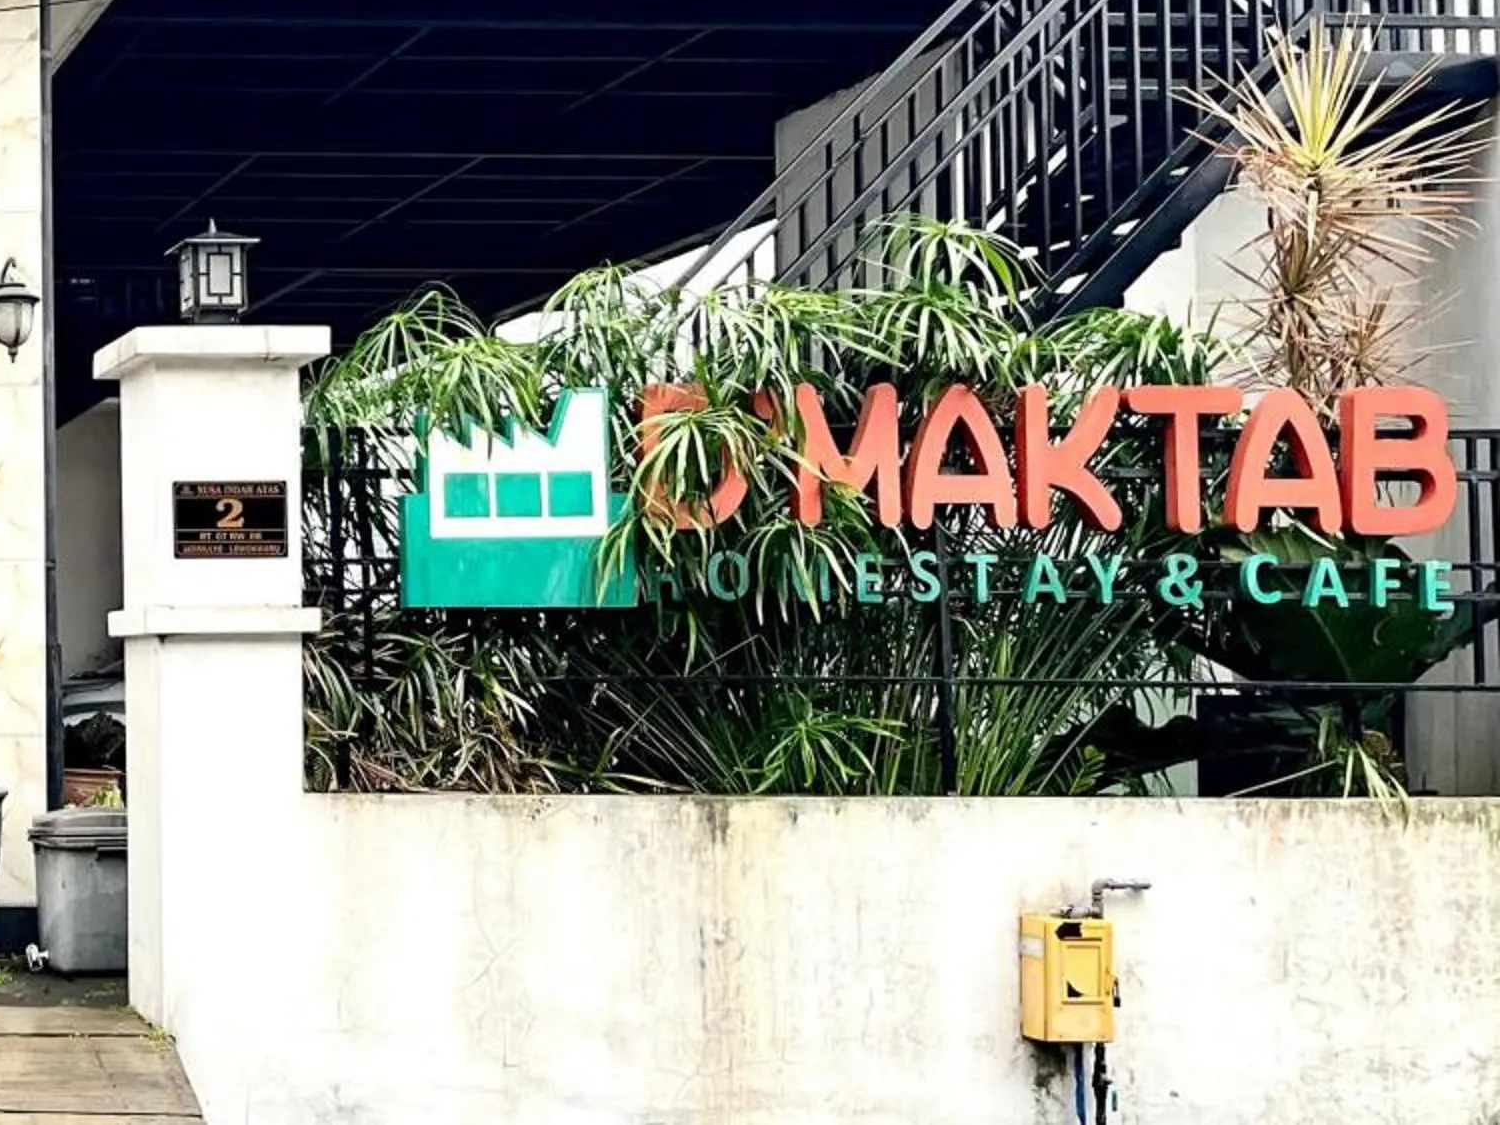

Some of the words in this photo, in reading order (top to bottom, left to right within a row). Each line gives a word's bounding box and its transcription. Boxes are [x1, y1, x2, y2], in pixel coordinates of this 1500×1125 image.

[215, 498, 245, 528] 2
[1158, 553, 1203, 608] &
[1241, 553, 1455, 612] CAFE
